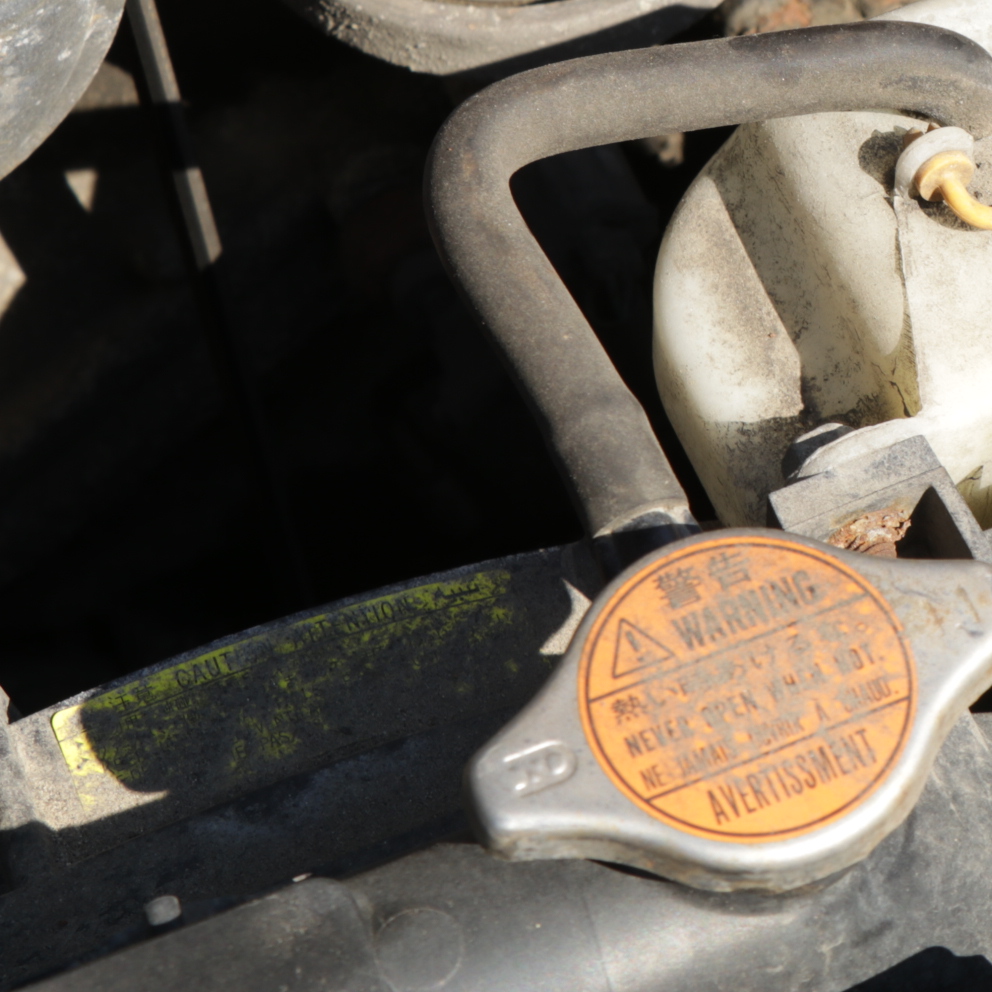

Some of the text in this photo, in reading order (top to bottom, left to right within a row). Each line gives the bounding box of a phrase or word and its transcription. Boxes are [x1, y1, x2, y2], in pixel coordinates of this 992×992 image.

[653, 551, 750, 608] 警告
[671, 569, 819, 651] WARNING
[624, 716, 693, 758] NEVER
[707, 730, 877, 823] AVERTISSMENT
